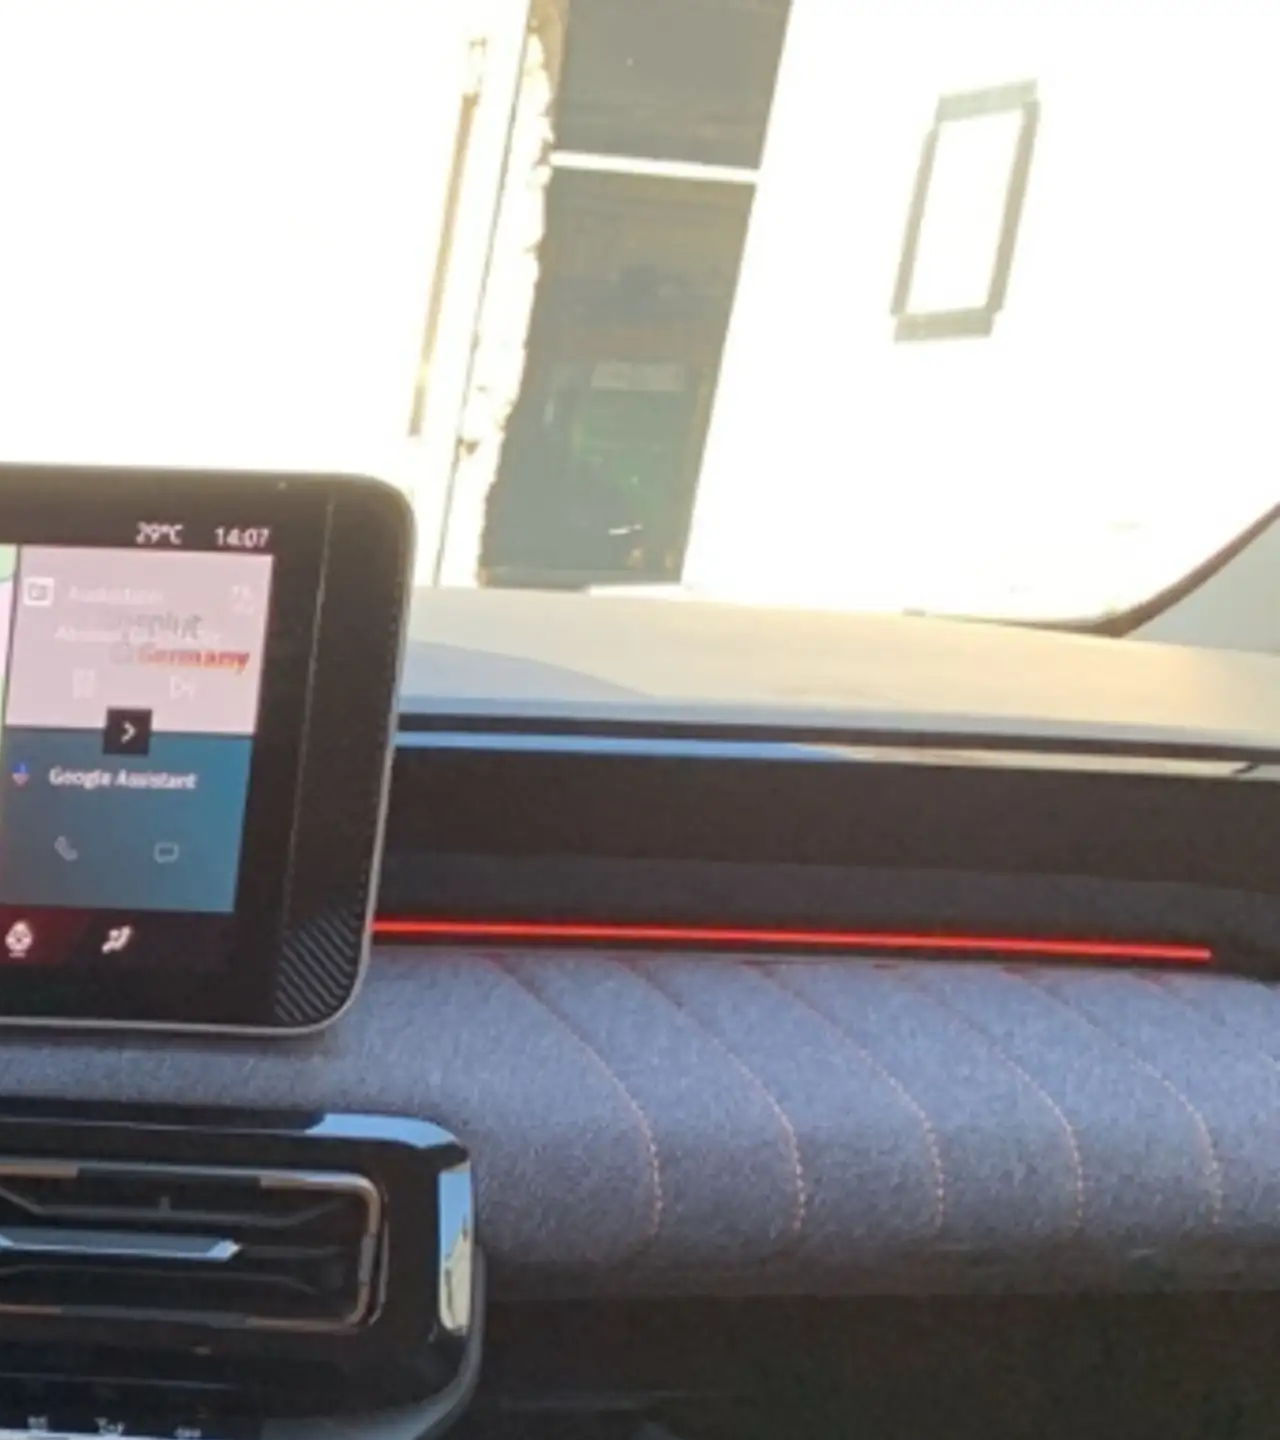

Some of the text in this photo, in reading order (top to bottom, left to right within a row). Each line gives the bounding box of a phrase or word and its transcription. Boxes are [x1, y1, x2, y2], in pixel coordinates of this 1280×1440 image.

[214, 526, 270, 548] 14:07
[137, 644, 251, 674] Germany
[48, 764, 199, 791] Google Assistant
